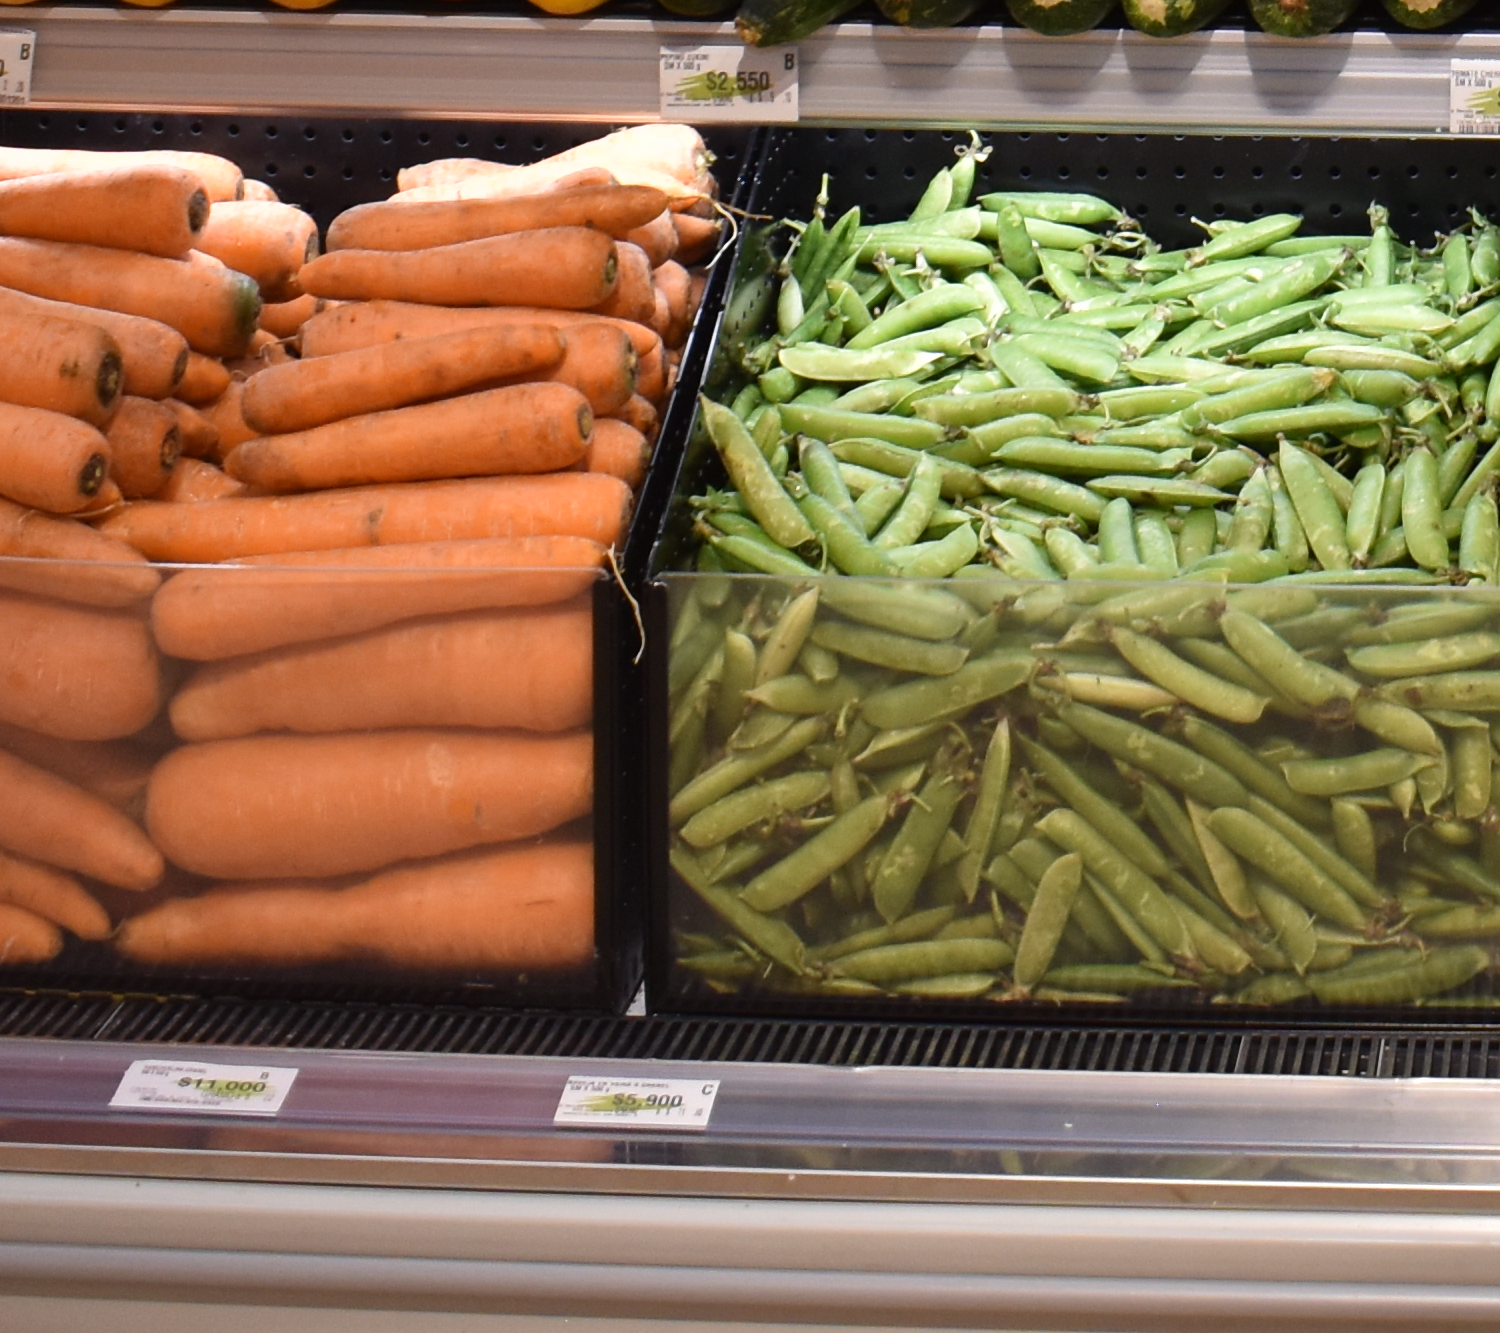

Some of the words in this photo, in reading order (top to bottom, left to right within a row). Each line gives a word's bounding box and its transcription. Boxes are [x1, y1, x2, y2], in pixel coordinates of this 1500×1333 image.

[20, 44, 29, 60] B
[784, 54, 794, 69] B
[706, 71, 769, 91] $2,550
[178, 1077, 266, 1093] $11,000
[702, 1084, 713, 1095] C
[612, 1094, 682, 1108] $5,900
